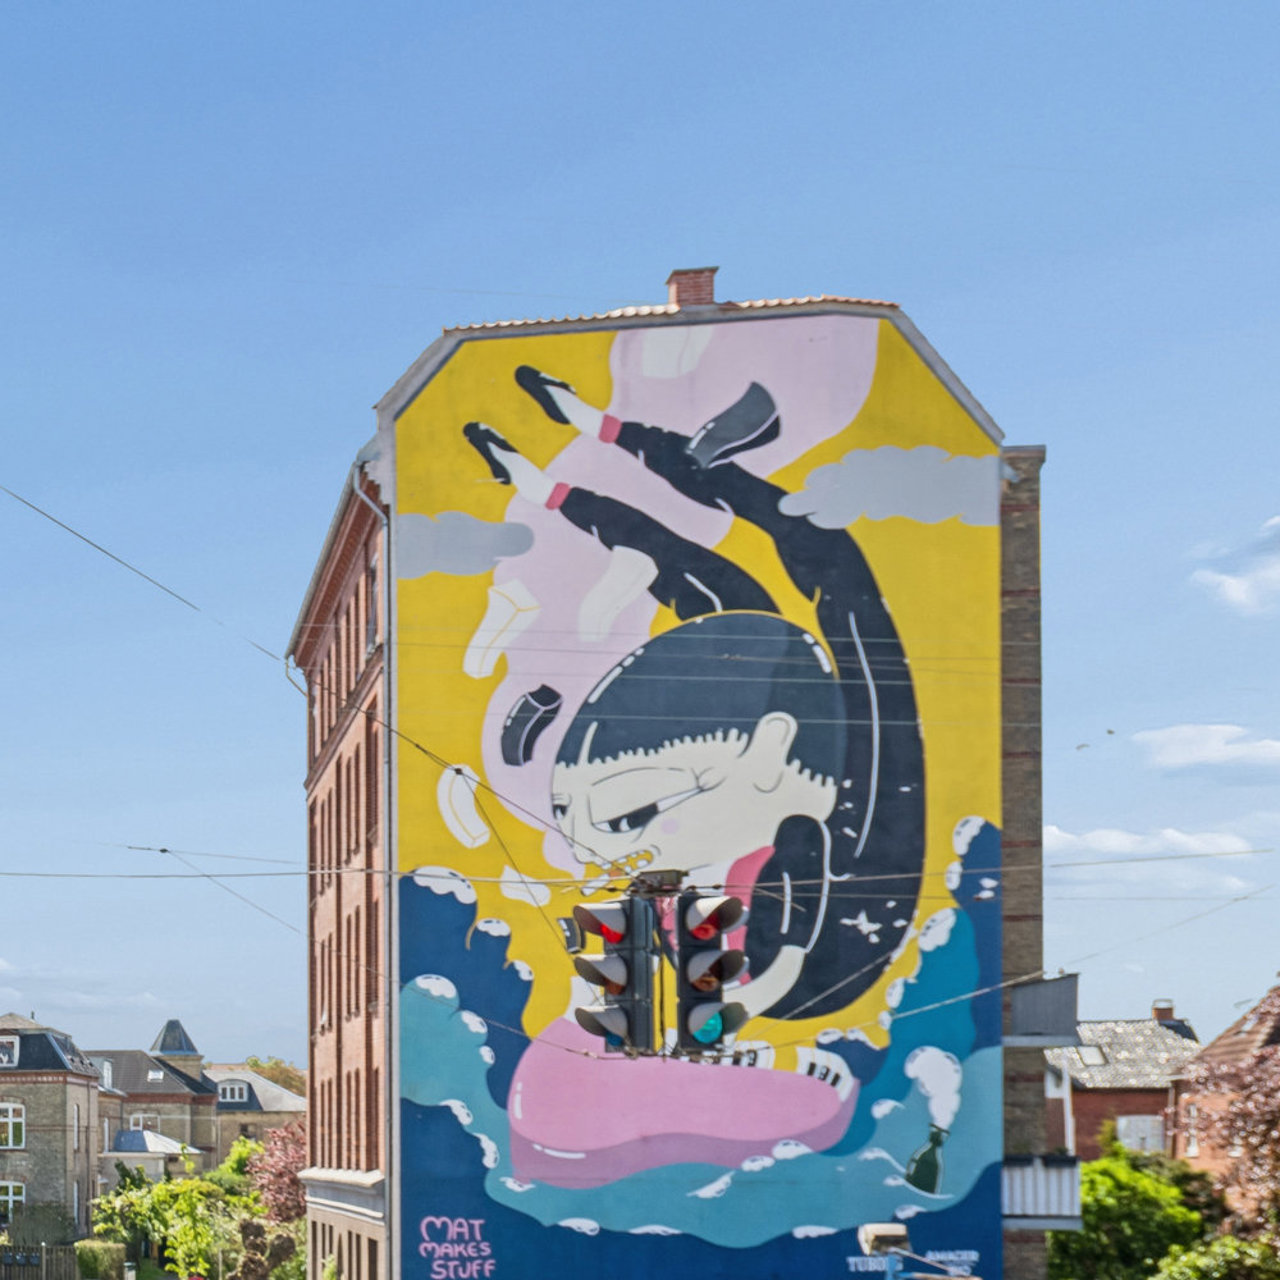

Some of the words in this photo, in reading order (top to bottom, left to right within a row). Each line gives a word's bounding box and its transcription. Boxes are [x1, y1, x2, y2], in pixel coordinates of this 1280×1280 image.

[420, 1215, 485, 1241] MAT
[418, 1242, 492, 1258] MAKES
[430, 1259, 496, 1280] STUFF
